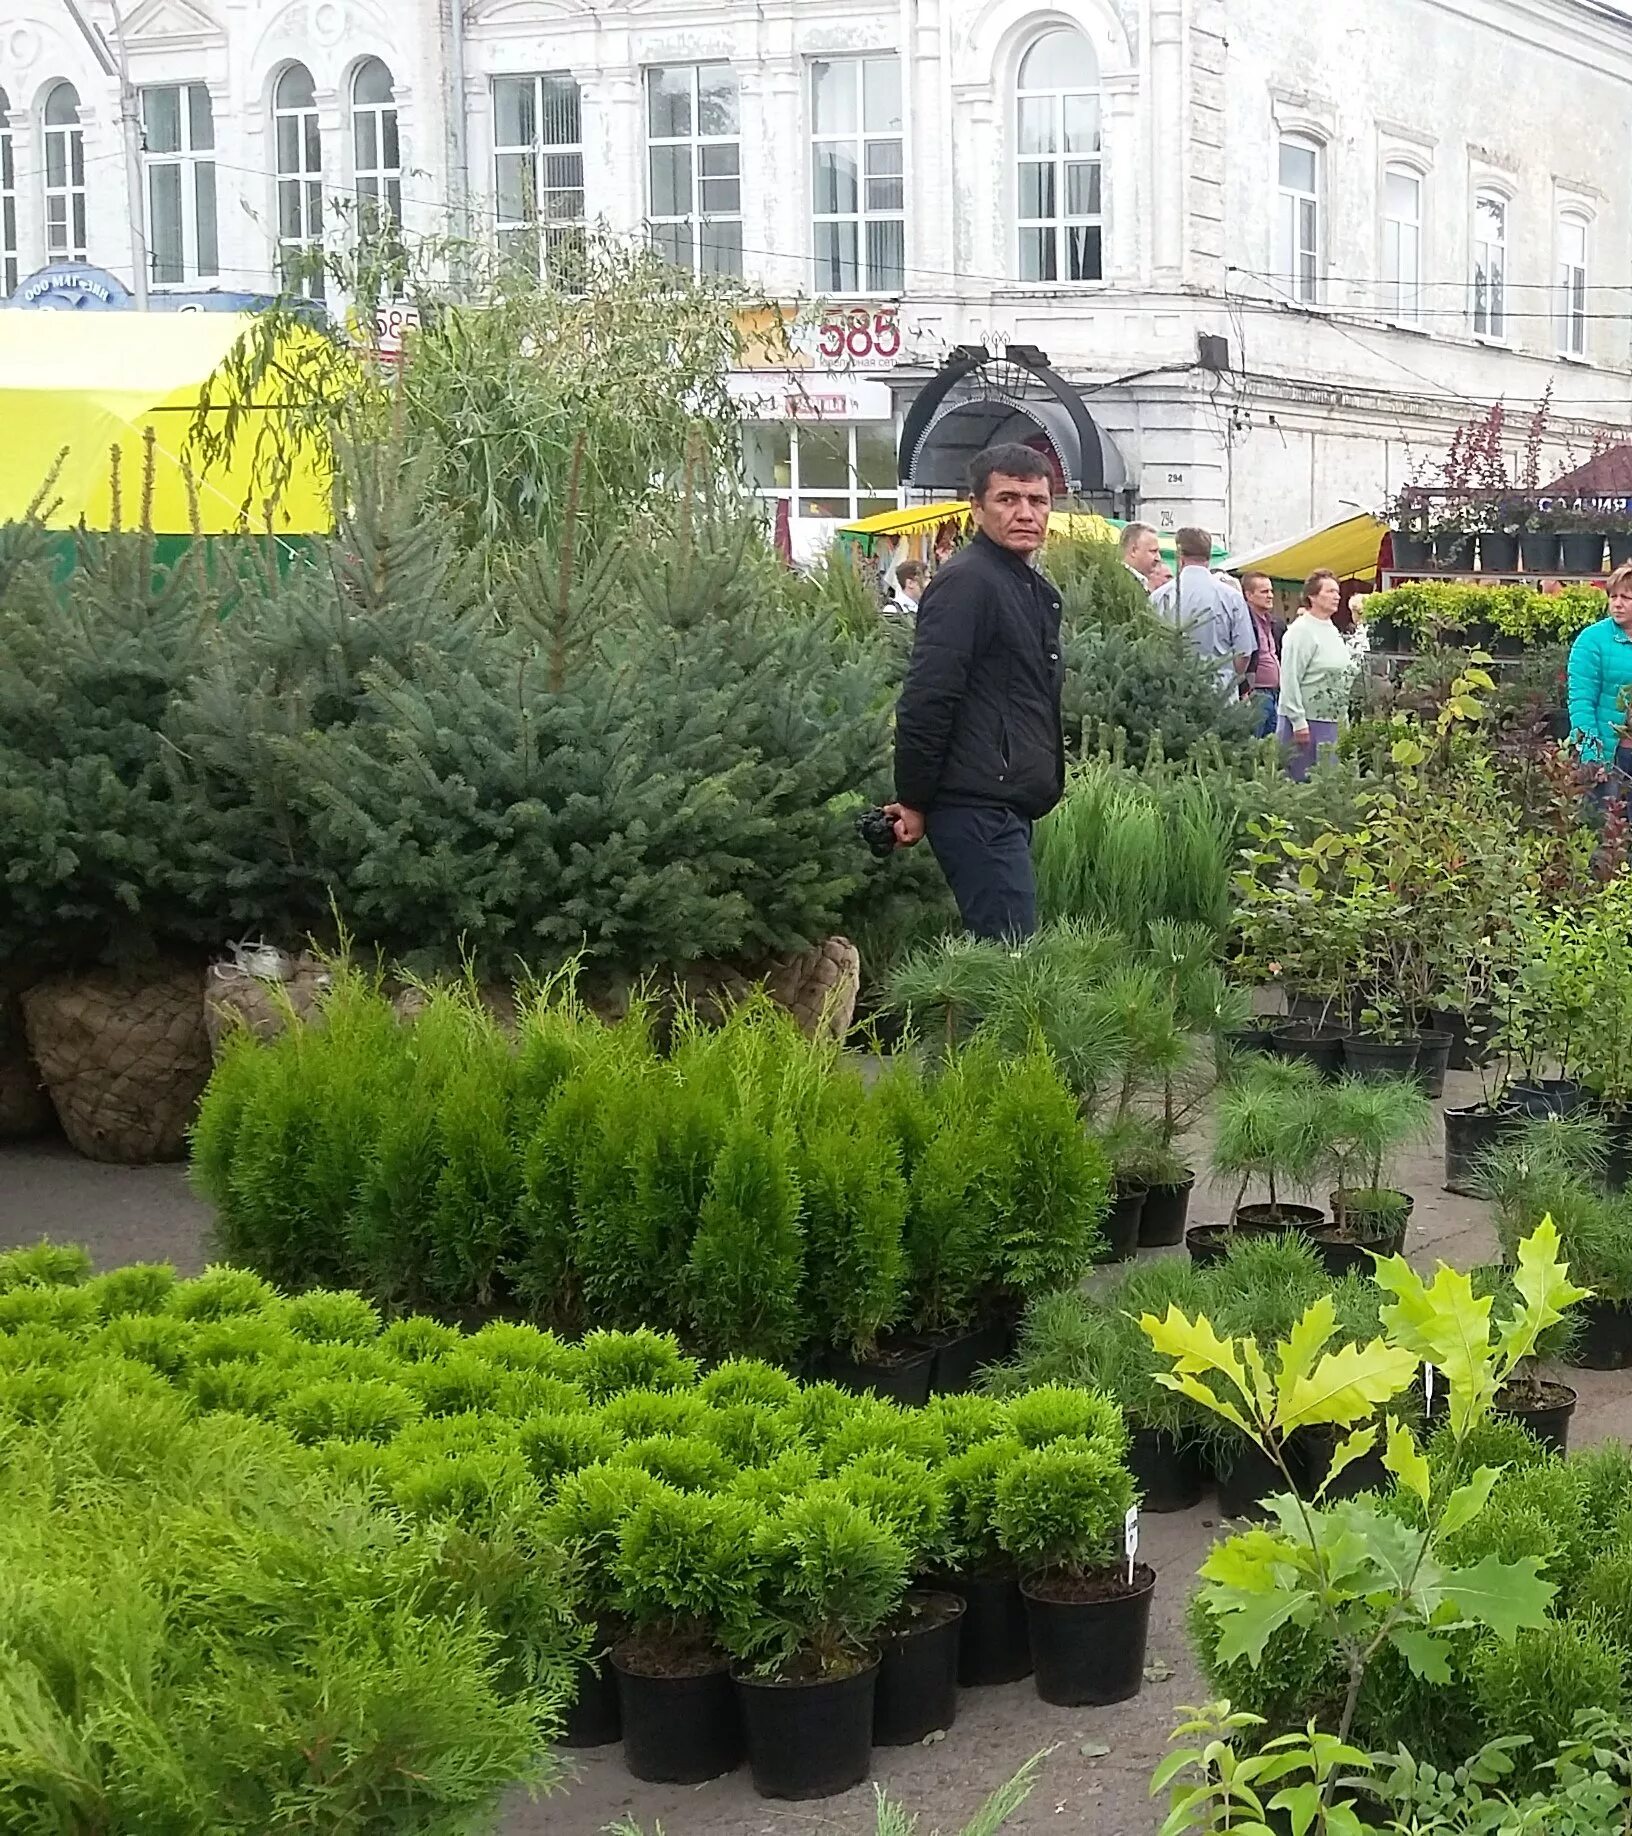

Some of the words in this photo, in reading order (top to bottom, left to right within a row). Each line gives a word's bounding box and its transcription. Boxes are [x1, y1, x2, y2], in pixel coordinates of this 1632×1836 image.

[24, 279, 50, 301] ООО
[819, 308, 901, 357] 585
[1168, 473, 1184, 483] 294
